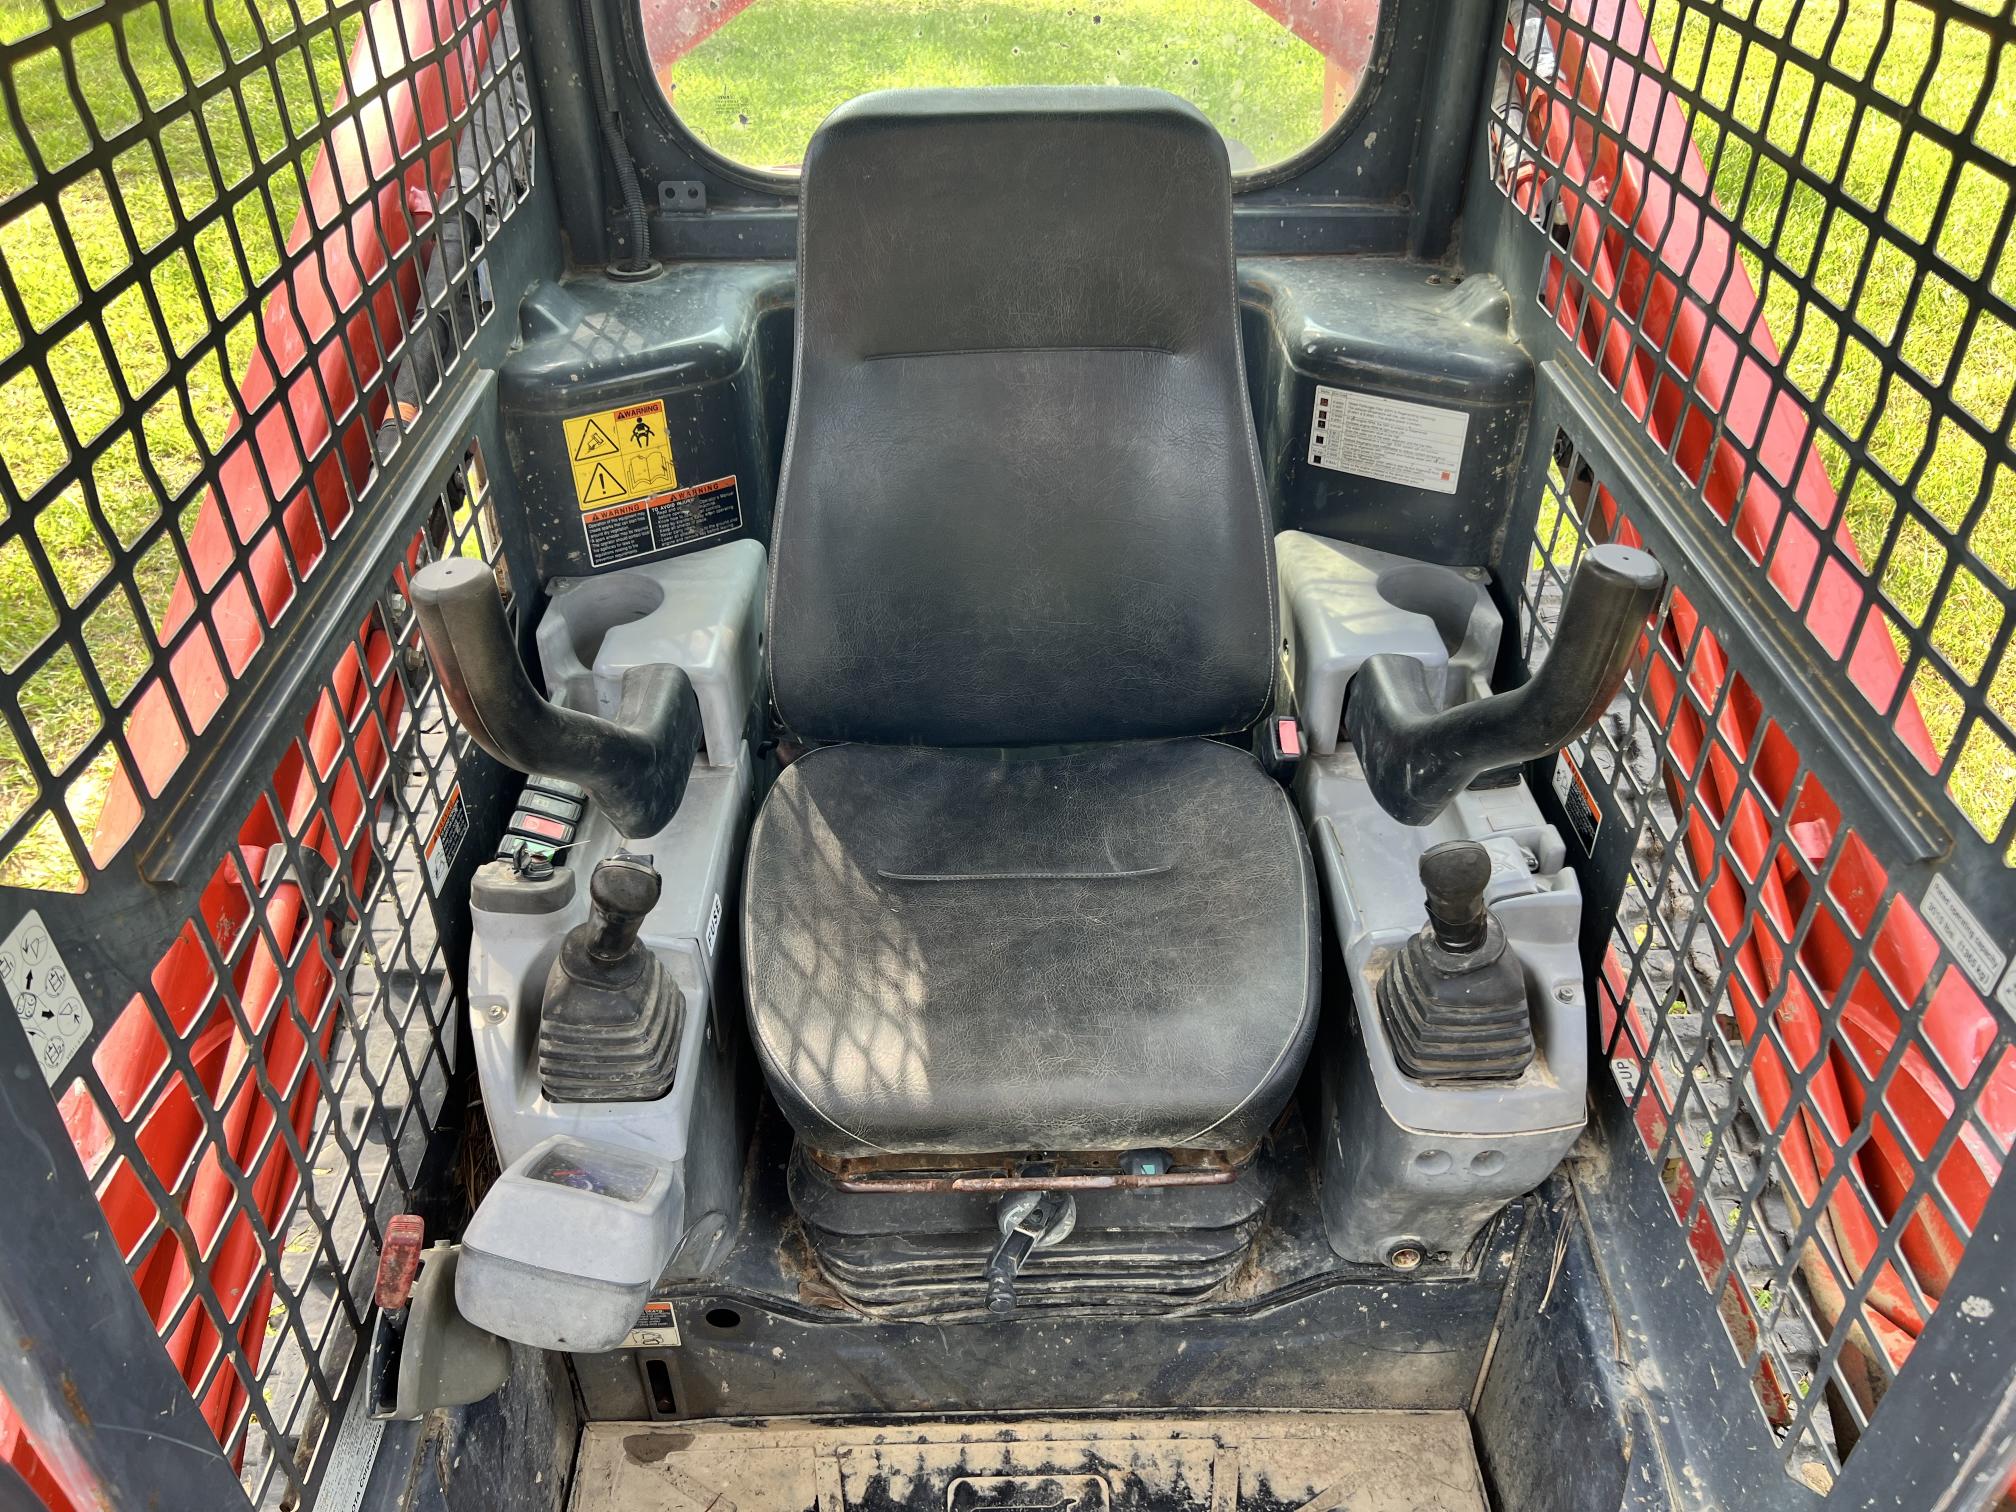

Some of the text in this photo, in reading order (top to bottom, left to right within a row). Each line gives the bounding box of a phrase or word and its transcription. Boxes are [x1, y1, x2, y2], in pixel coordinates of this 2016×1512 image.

[624, 404, 659, 418] WARNING
[679, 483, 719, 499] WARNING
[600, 504, 640, 519] WARNING
[708, 899, 721, 948] FUSE
[1617, 1061, 1632, 1080] UP
[359, 1424, 382, 1488] Corporation
